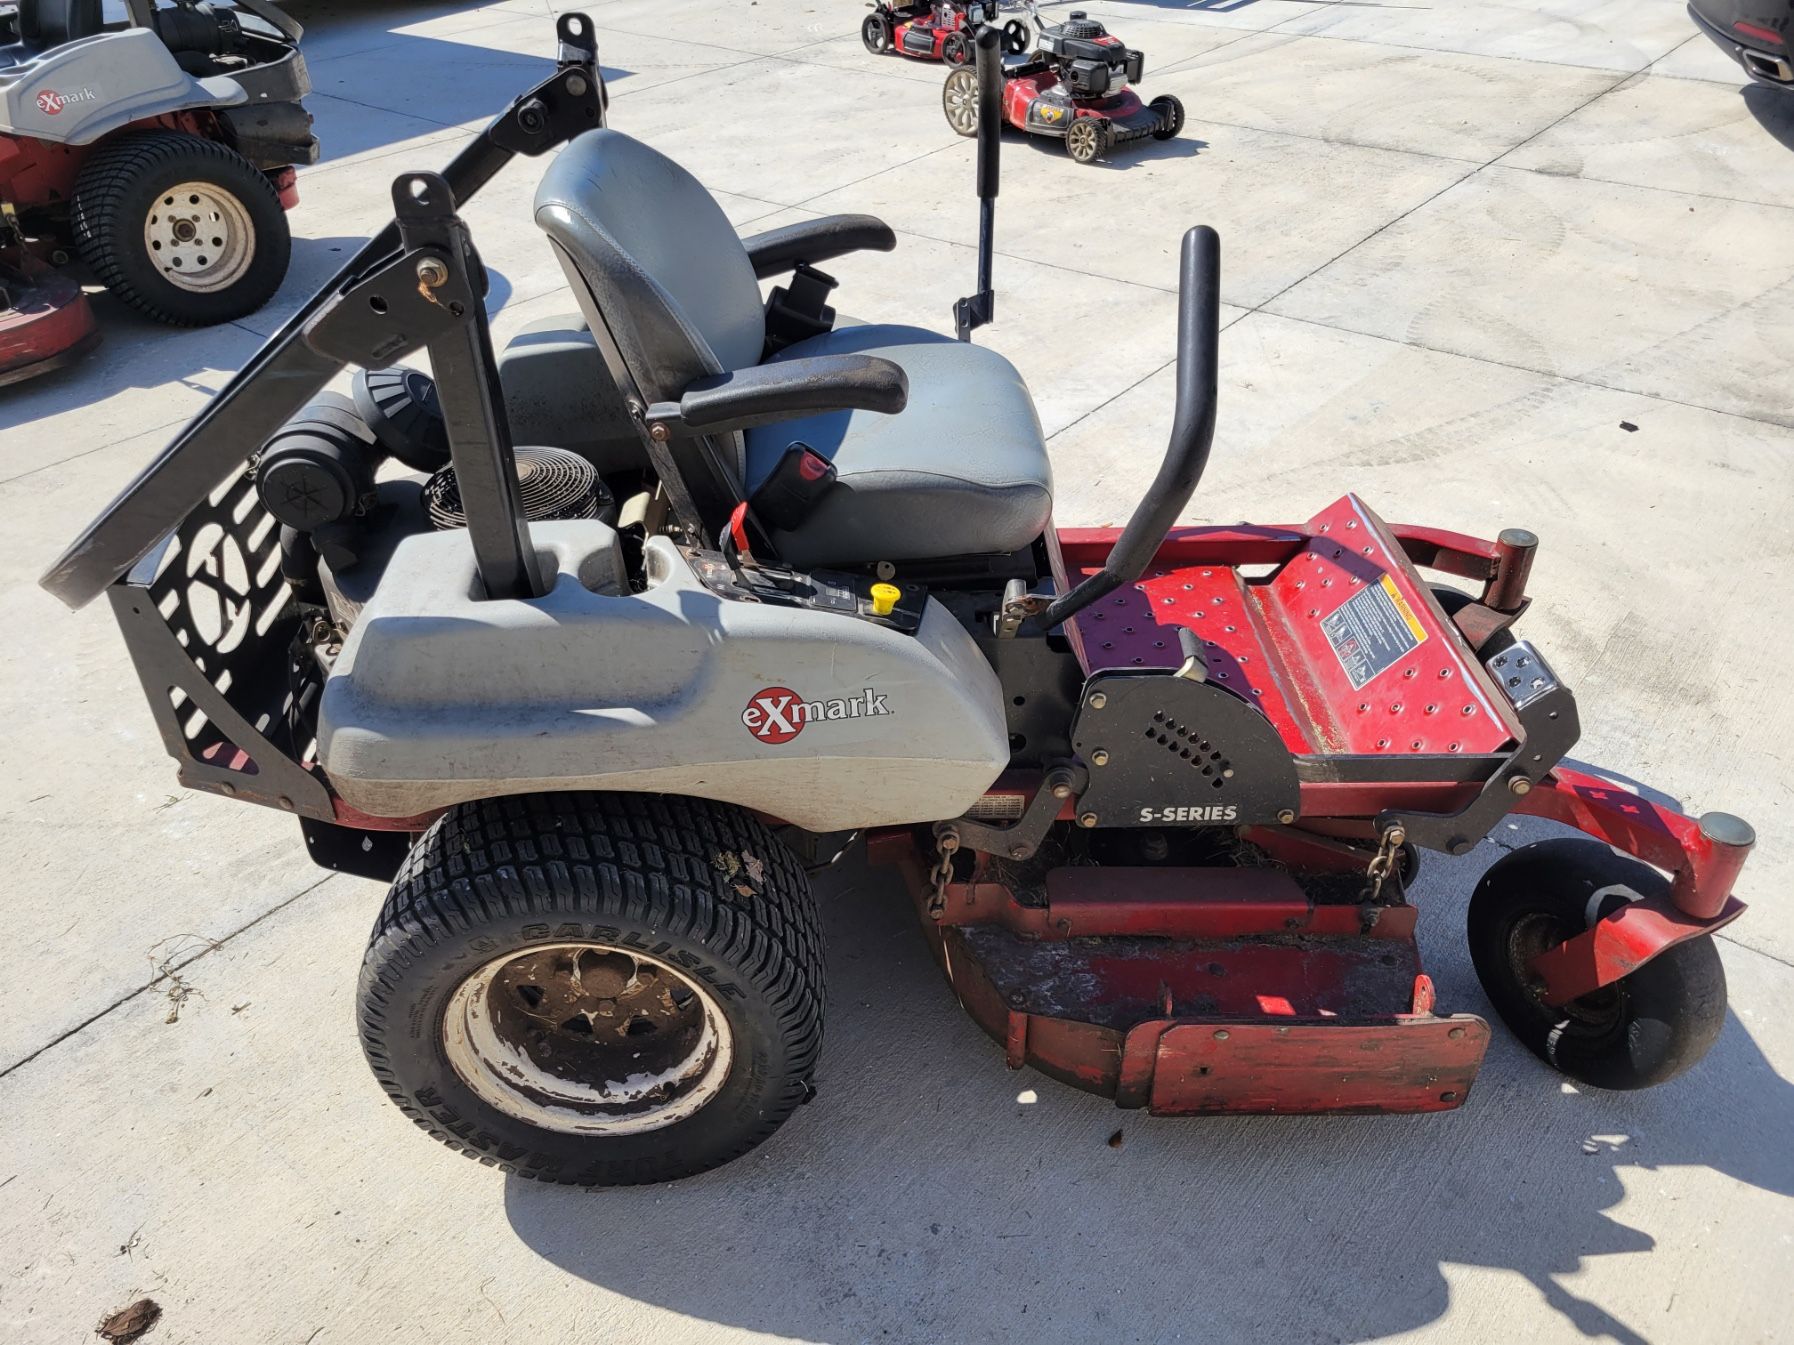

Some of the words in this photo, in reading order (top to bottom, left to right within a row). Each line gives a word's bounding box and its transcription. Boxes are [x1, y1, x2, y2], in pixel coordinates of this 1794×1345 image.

[1140, 806, 1238, 823] S-SERIES
[522, 923, 748, 1001] CARLISLE
[414, 1086, 564, 1175] MASTER
